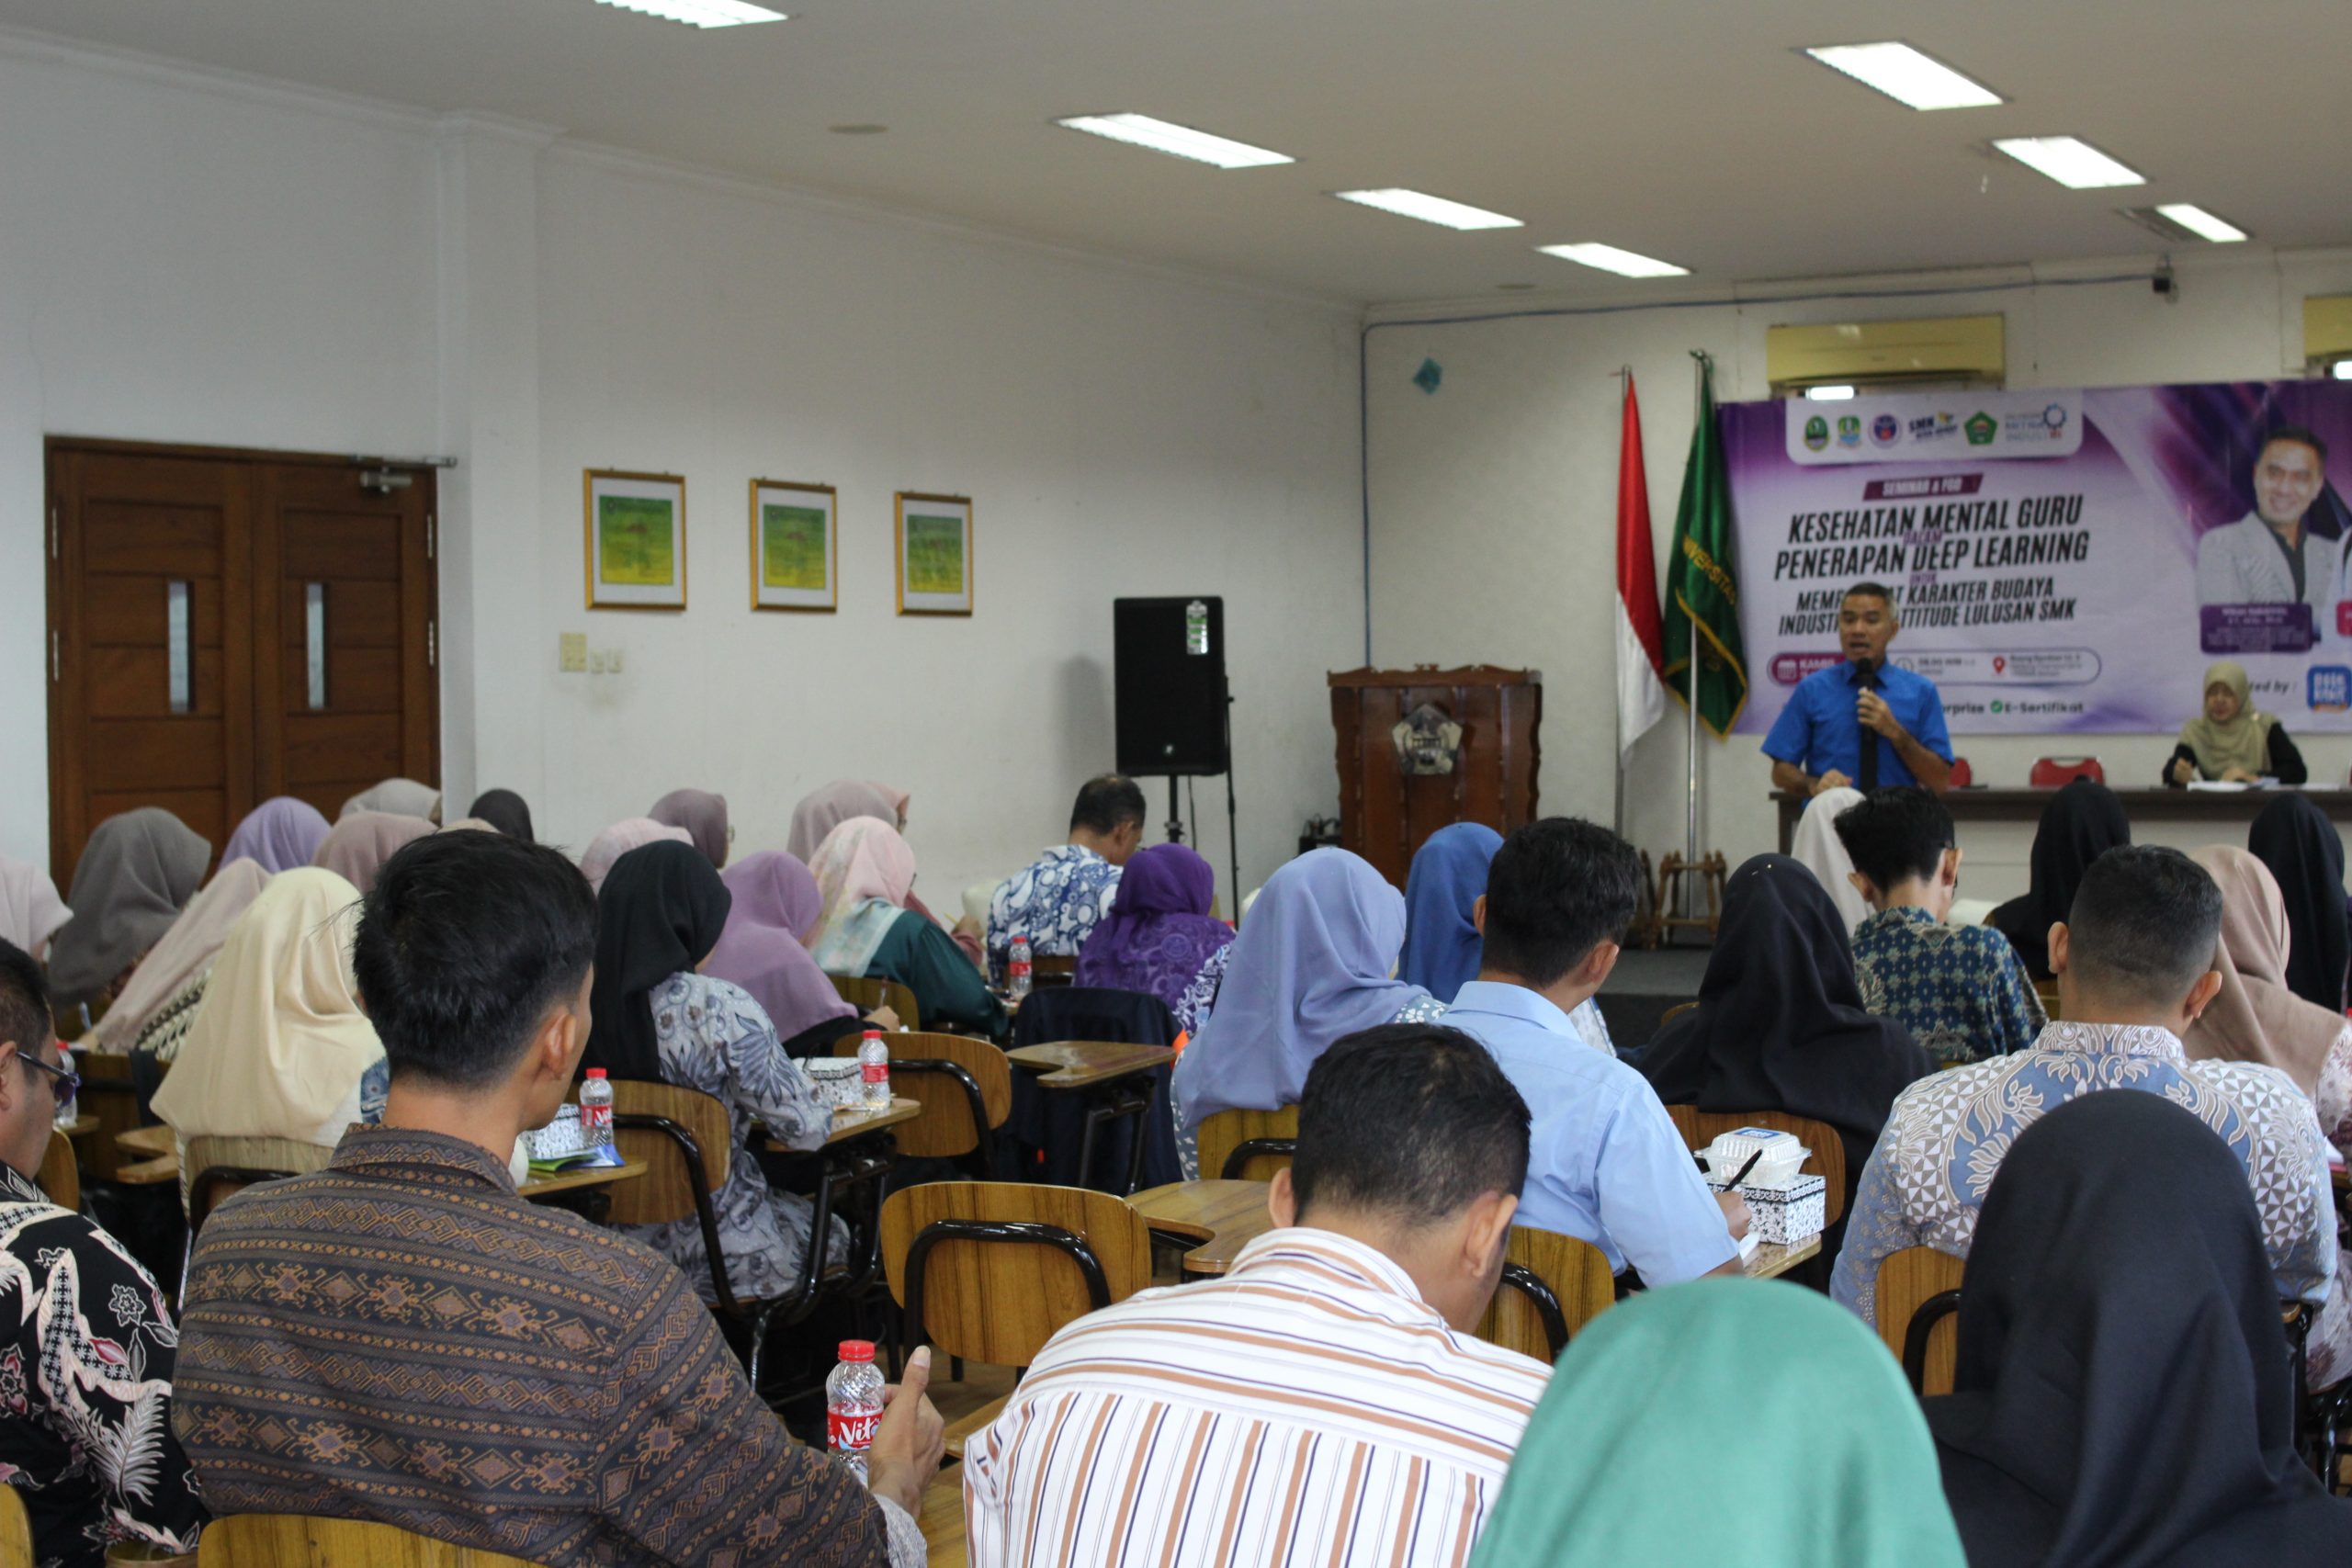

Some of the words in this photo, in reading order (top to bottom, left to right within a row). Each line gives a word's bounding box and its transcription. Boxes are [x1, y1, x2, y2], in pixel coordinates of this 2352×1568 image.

[1788, 504, 1917, 544] KESEHATAN
[1922, 500, 2009, 536] MENTAL
[2016, 494, 2083, 527] GURU
[1774, 544, 1905, 581] PENERAPAN
[1911, 539, 1969, 572] DEEP
[1973, 531, 2089, 569] LEARNING
[1906, 581, 1985, 605] KARAKTER
[1992, 577, 2053, 601] BUDAYA
[1896, 604, 1960, 628] TTITUDE
[1963, 604, 2034, 626] LULUSAN
[2039, 599, 2076, 621] SMK
